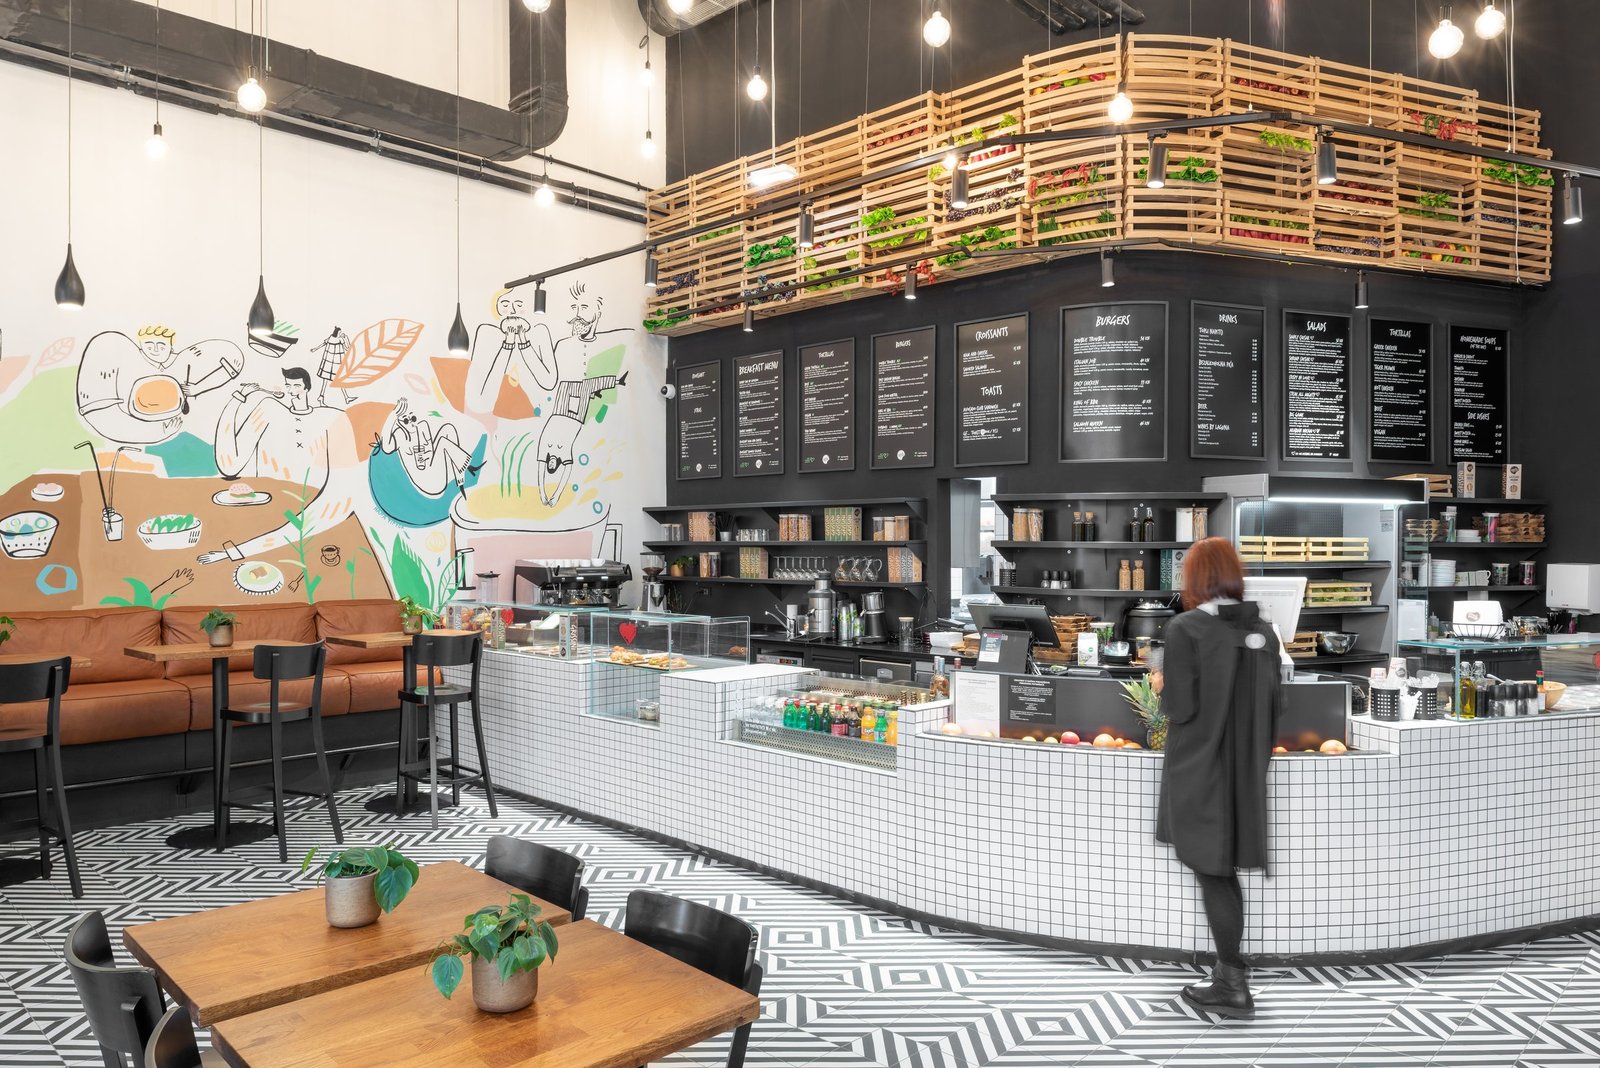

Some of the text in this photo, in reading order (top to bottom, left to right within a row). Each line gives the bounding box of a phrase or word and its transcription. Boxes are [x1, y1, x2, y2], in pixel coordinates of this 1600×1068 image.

[1095, 314, 1131, 328] BURGERS
[1218, 313, 1238, 325] DRINKS
[1306, 320, 1328, 333] SALADS
[975, 326, 1009, 342] CROISSANTS
[1389, 328, 1412, 339] TORTILLAS
[738, 360, 779, 376] BREAKFAST MENU
[980, 384, 1003, 397] TOASTS
